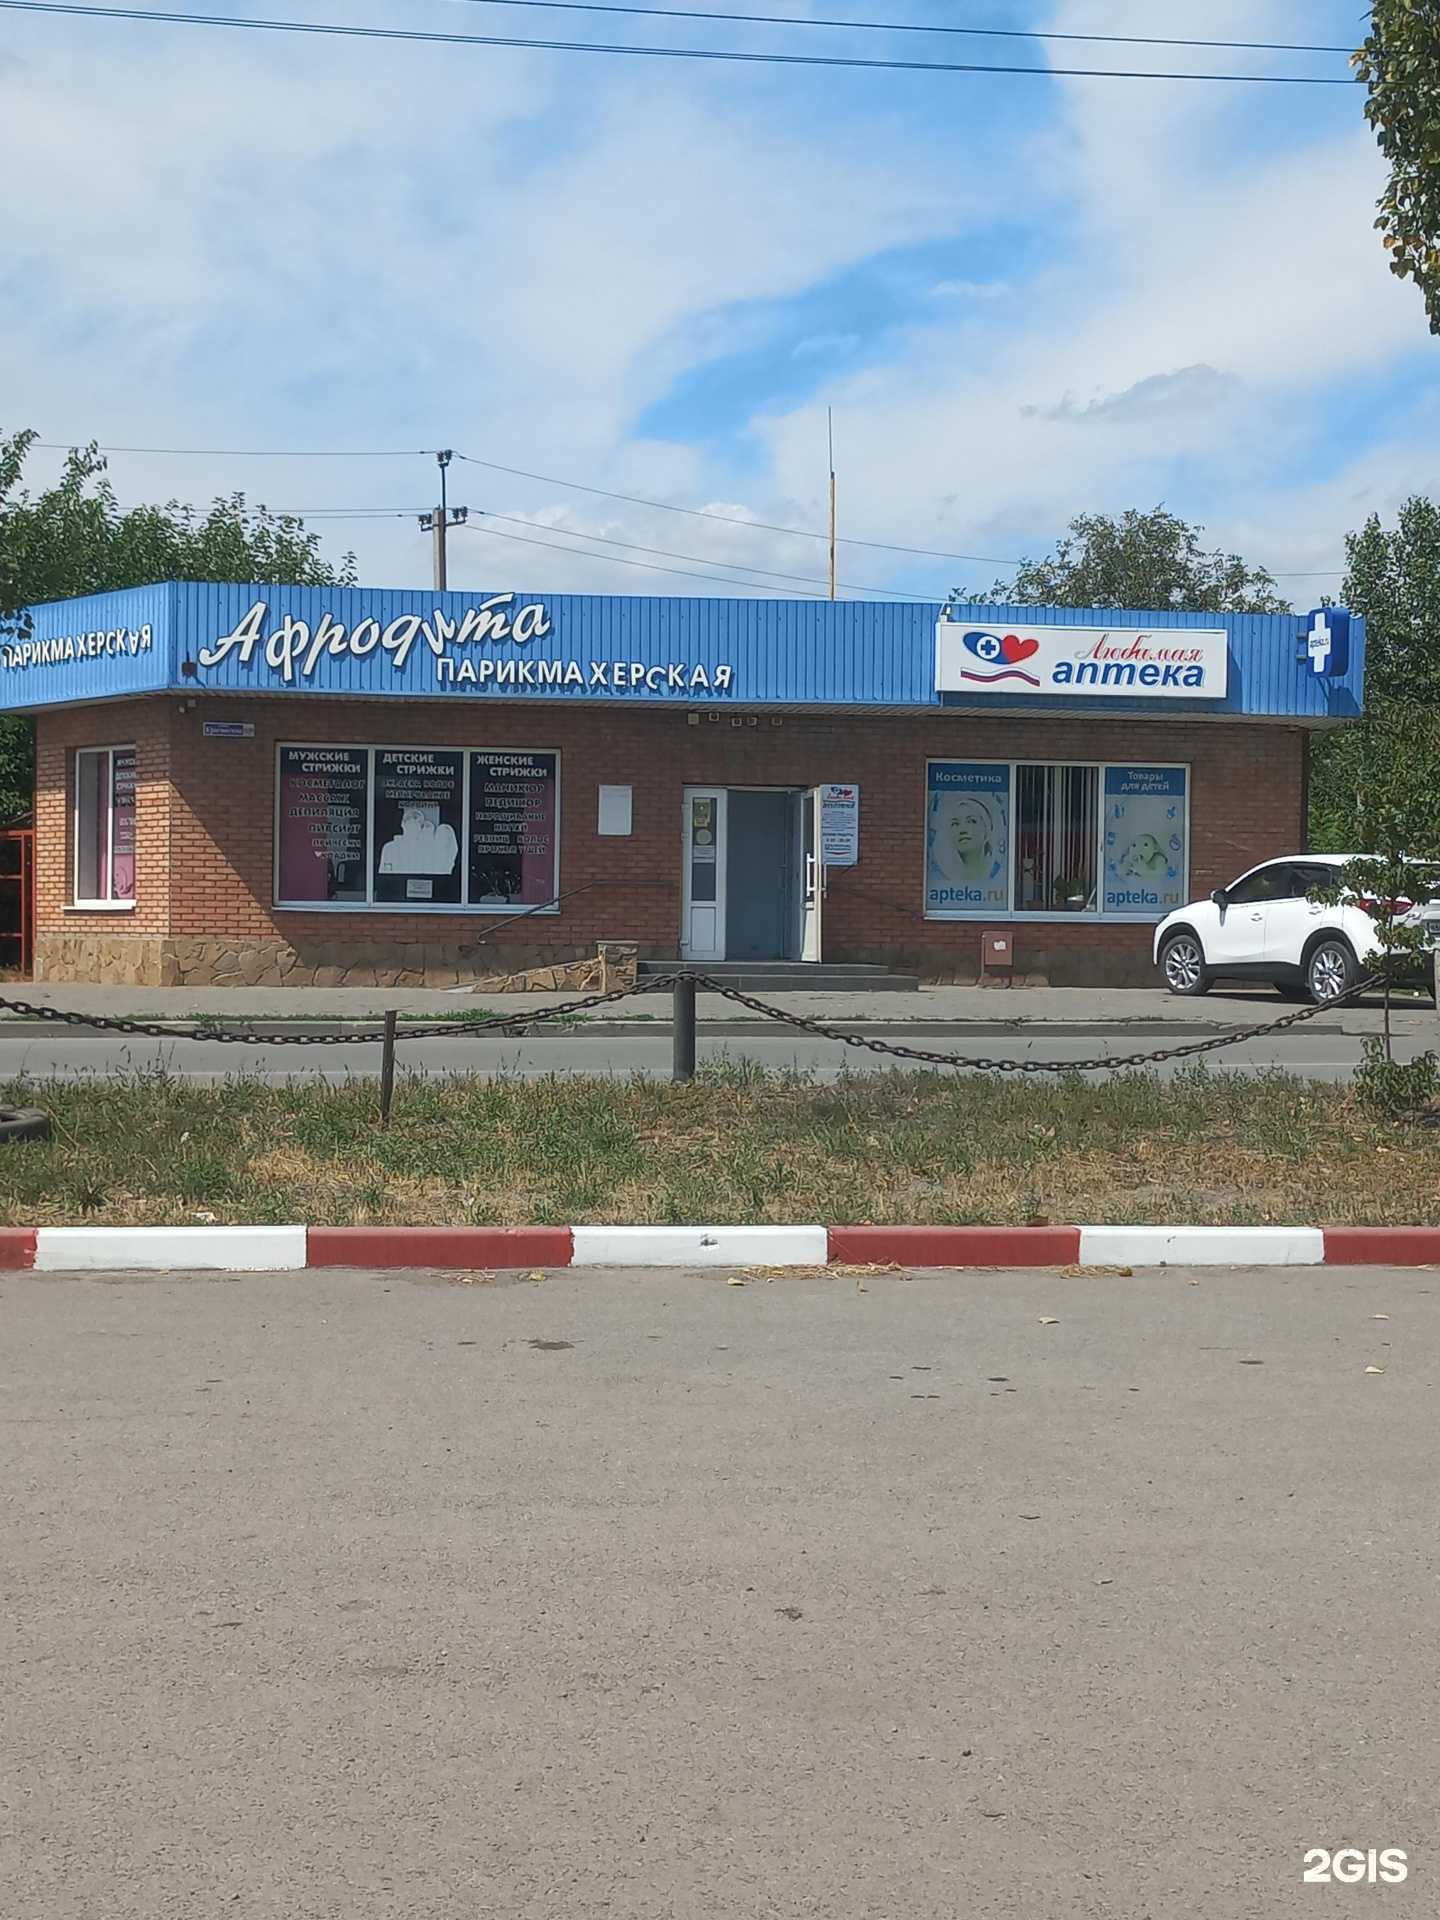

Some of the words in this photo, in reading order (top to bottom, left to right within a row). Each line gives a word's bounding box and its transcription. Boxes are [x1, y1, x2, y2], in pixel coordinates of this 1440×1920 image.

[198, 592, 552, 682] Афродита
[1074, 631, 1204, 663] Любимая
[1052, 658, 1205, 690] аптека
[288, 751, 350, 761] МУЖСКИЕ
[383, 752, 435, 764] ДЕТСКИЕ
[476, 755, 534, 765] ЖЕНСКИЕ
[302, 763, 361, 773] СТРИЖКИ
[396, 765, 455, 776] СТРИЖКИ
[489, 767, 548, 777] СТРИЖКИ
[935, 771, 1002, 784] Косметика
[1127, 770, 1164, 784] Товары
[1120, 782, 1140, 792] для
[1141, 781, 1170, 792] детей
[929, 885, 1004, 905] apteka.ru
[1106, 888, 1179, 907] apteka.ru
